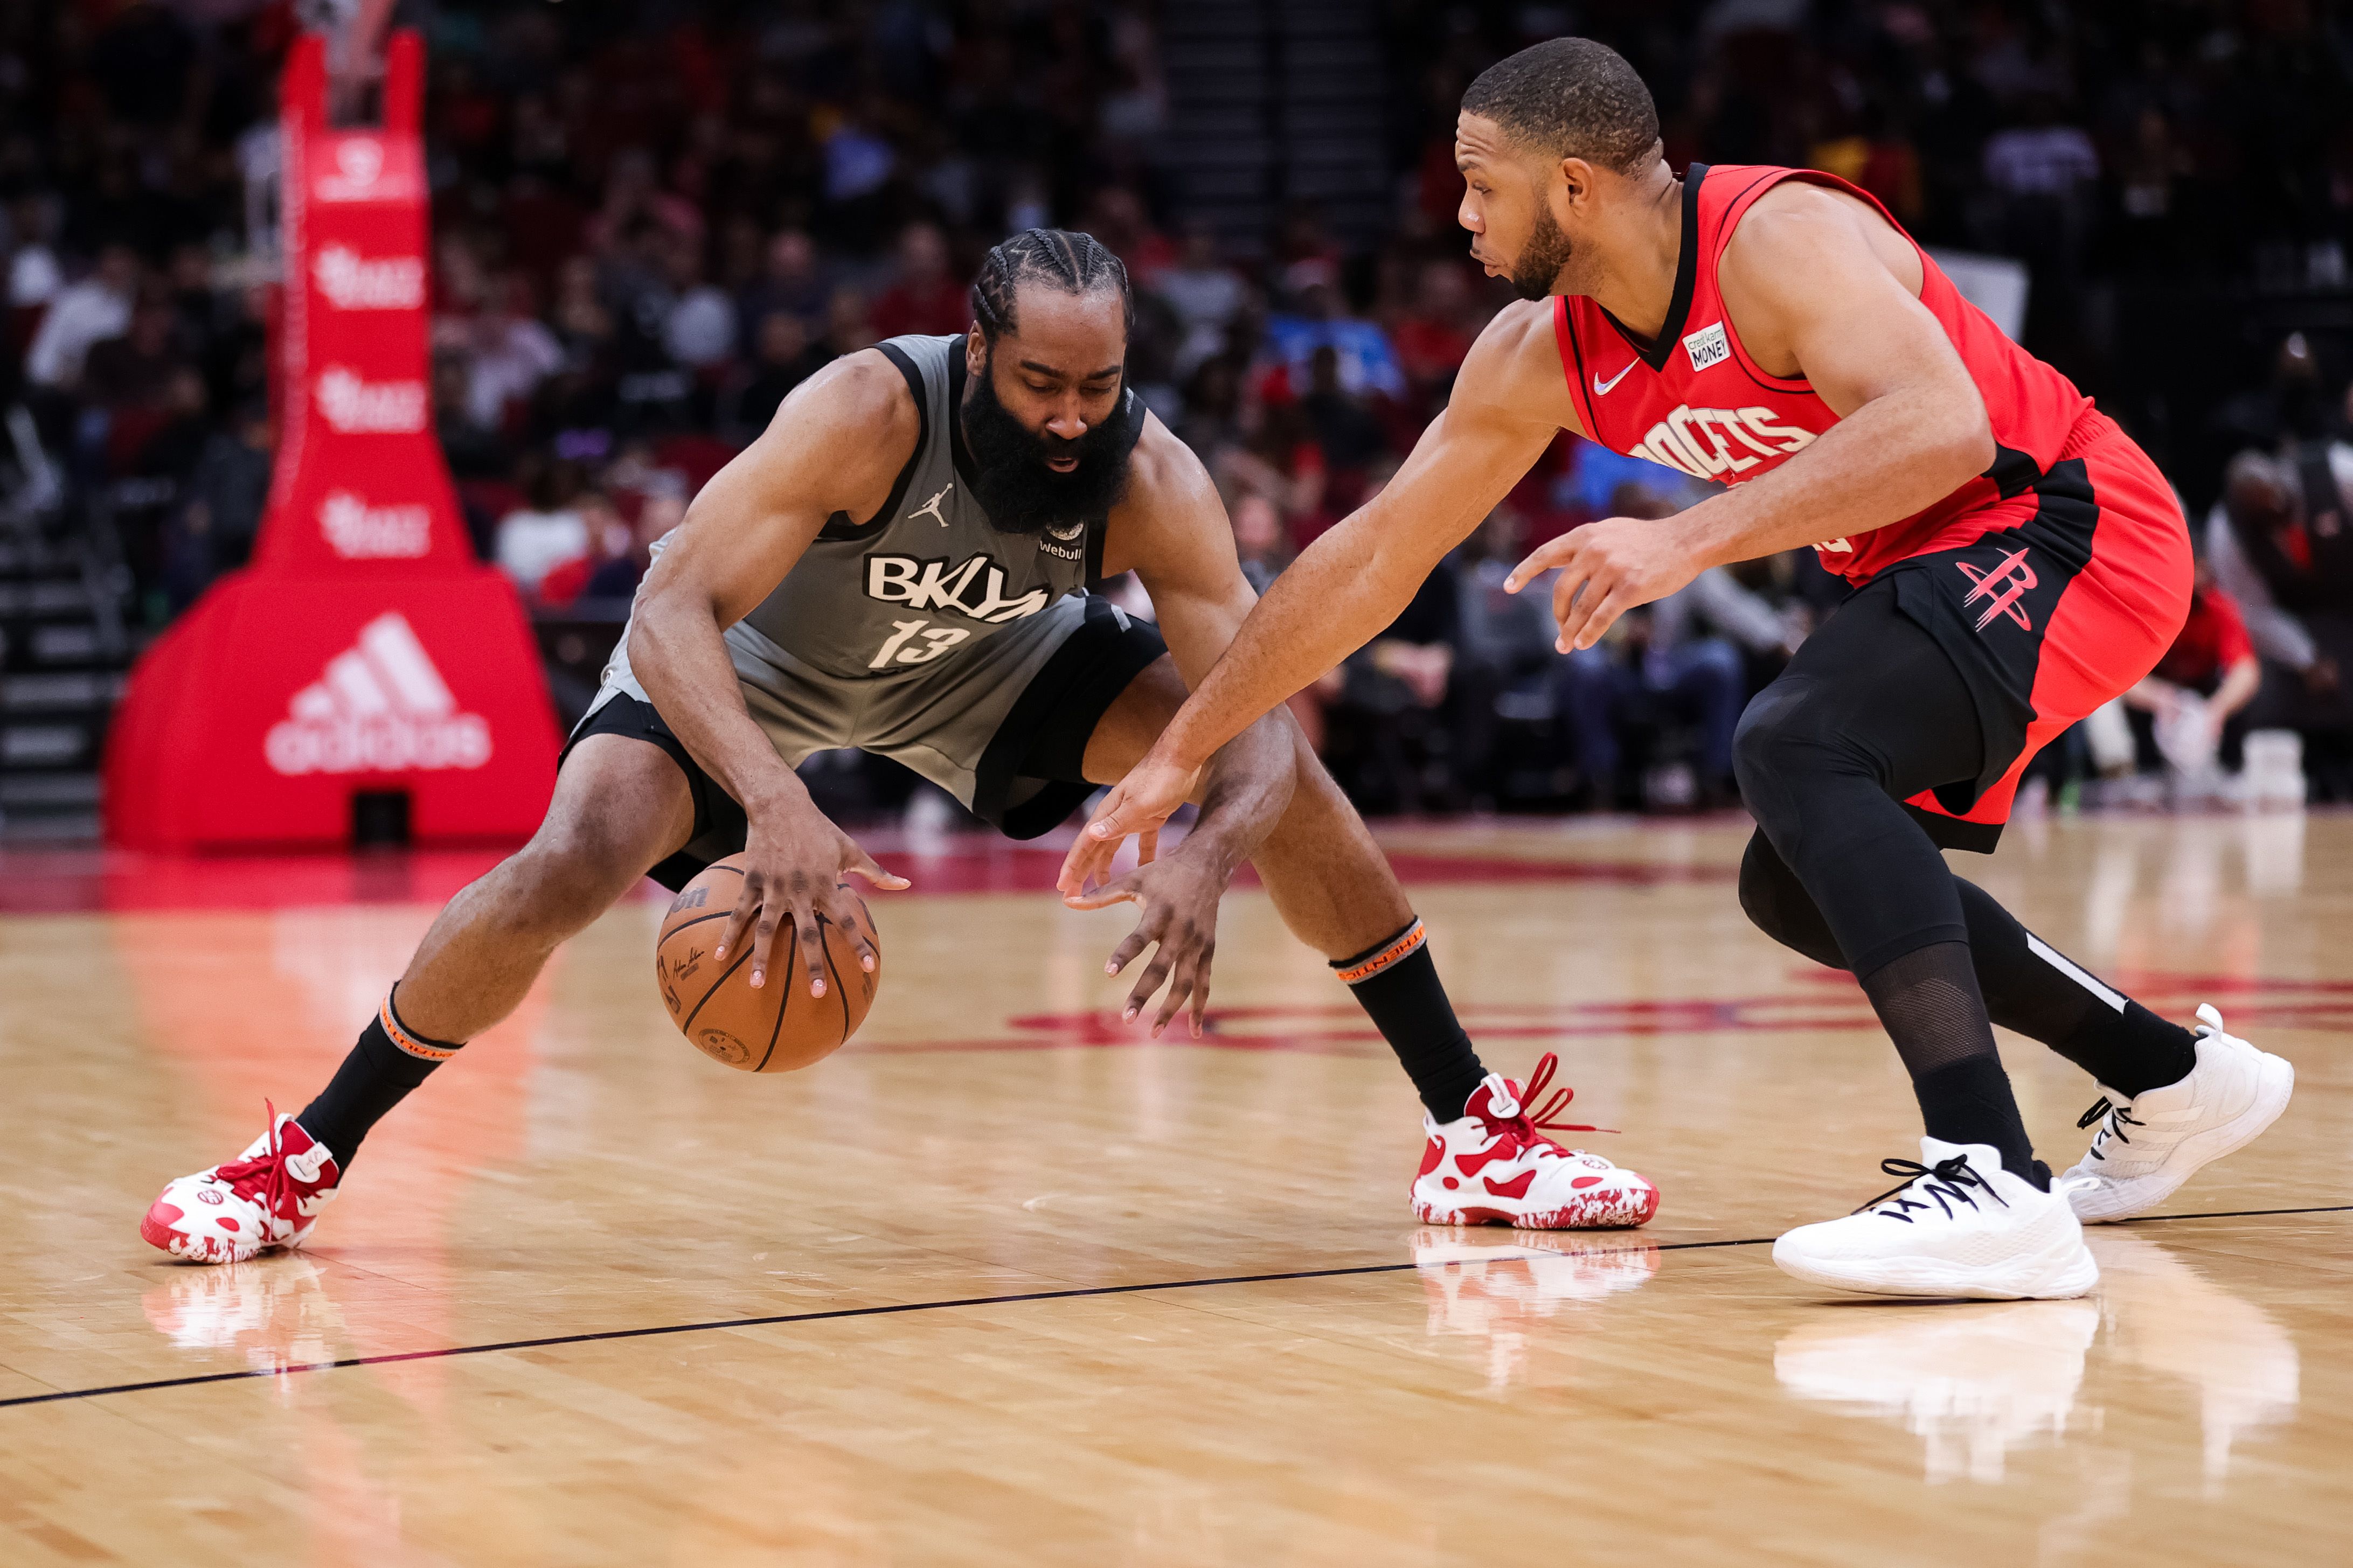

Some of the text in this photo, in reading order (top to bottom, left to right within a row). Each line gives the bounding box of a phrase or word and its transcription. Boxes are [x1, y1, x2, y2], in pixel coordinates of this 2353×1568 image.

[1692, 337, 1726, 367] MONEY
[1039, 540, 1082, 560] Webull
[867, 619, 970, 669] 13
[265, 714, 492, 775] adidas
